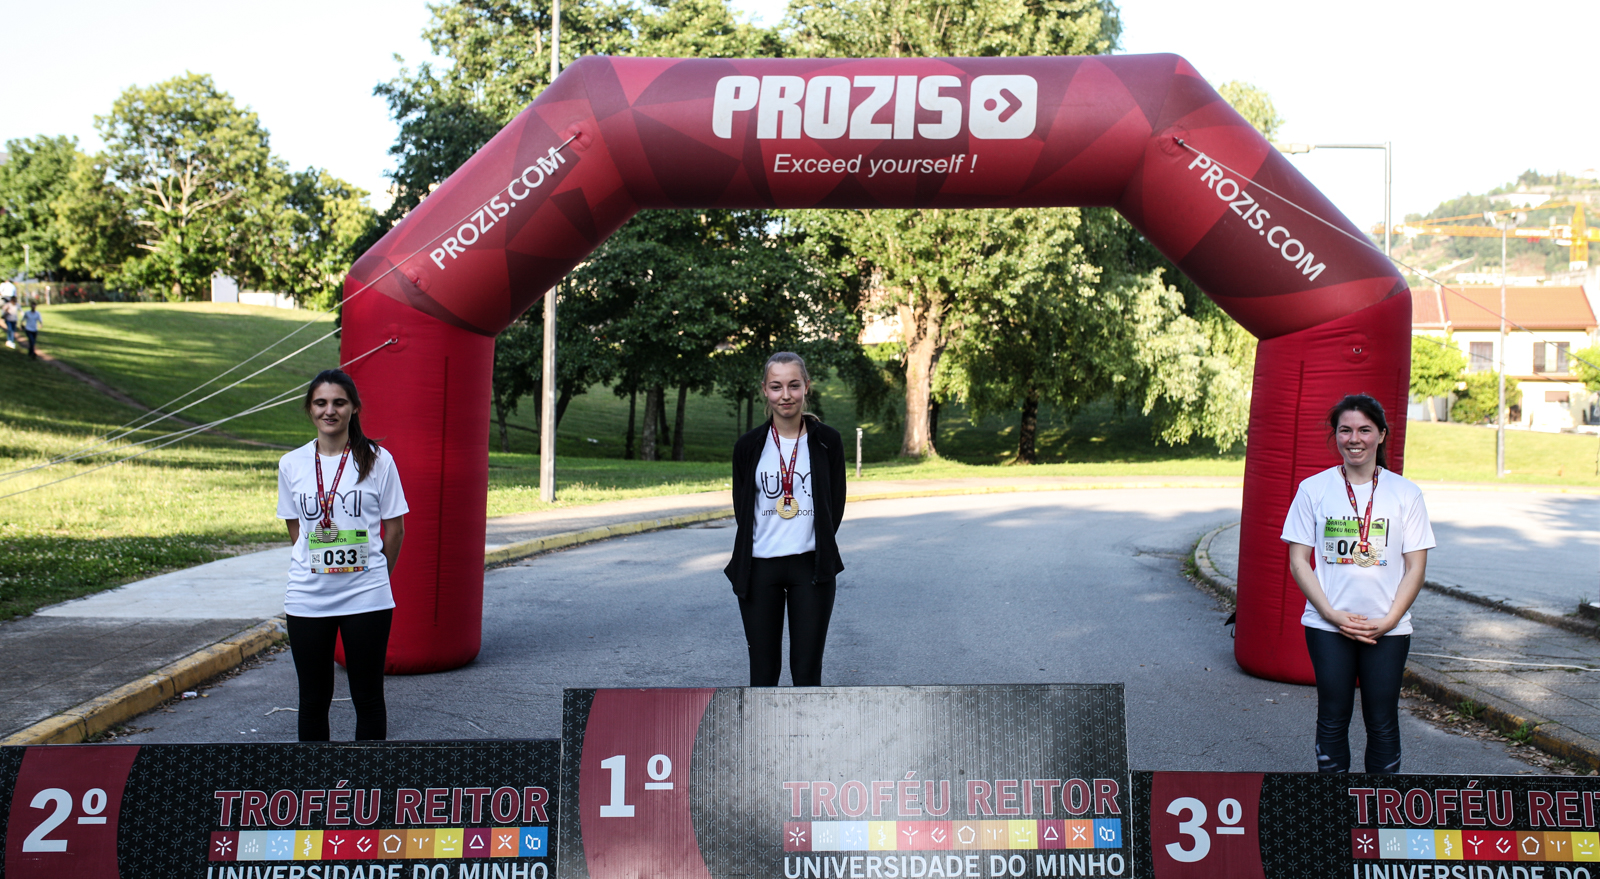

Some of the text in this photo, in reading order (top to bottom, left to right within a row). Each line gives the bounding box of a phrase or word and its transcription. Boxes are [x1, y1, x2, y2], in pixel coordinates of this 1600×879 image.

[712, 75, 963, 140] PROZIS
[773, 154, 862, 173] Exceed
[867, 154, 966, 177] yourself
[429, 146, 567, 270] PROZIS.COM
[1188, 152, 1326, 282] PROZIS.COM
[324, 549, 357, 565] 033
[214, 780, 549, 826] TROFÉU REITOR
[600, 753, 674, 817] 1º
[783, 771, 1121, 818] TROFÉU REITOR
[1348, 780, 1514, 827] TROFÉU
[22, 787, 108, 853] 2º
[1165, 796, 1245, 863] 3º
[784, 853, 1125, 879] UNIVERSIDADE DO MINHO
